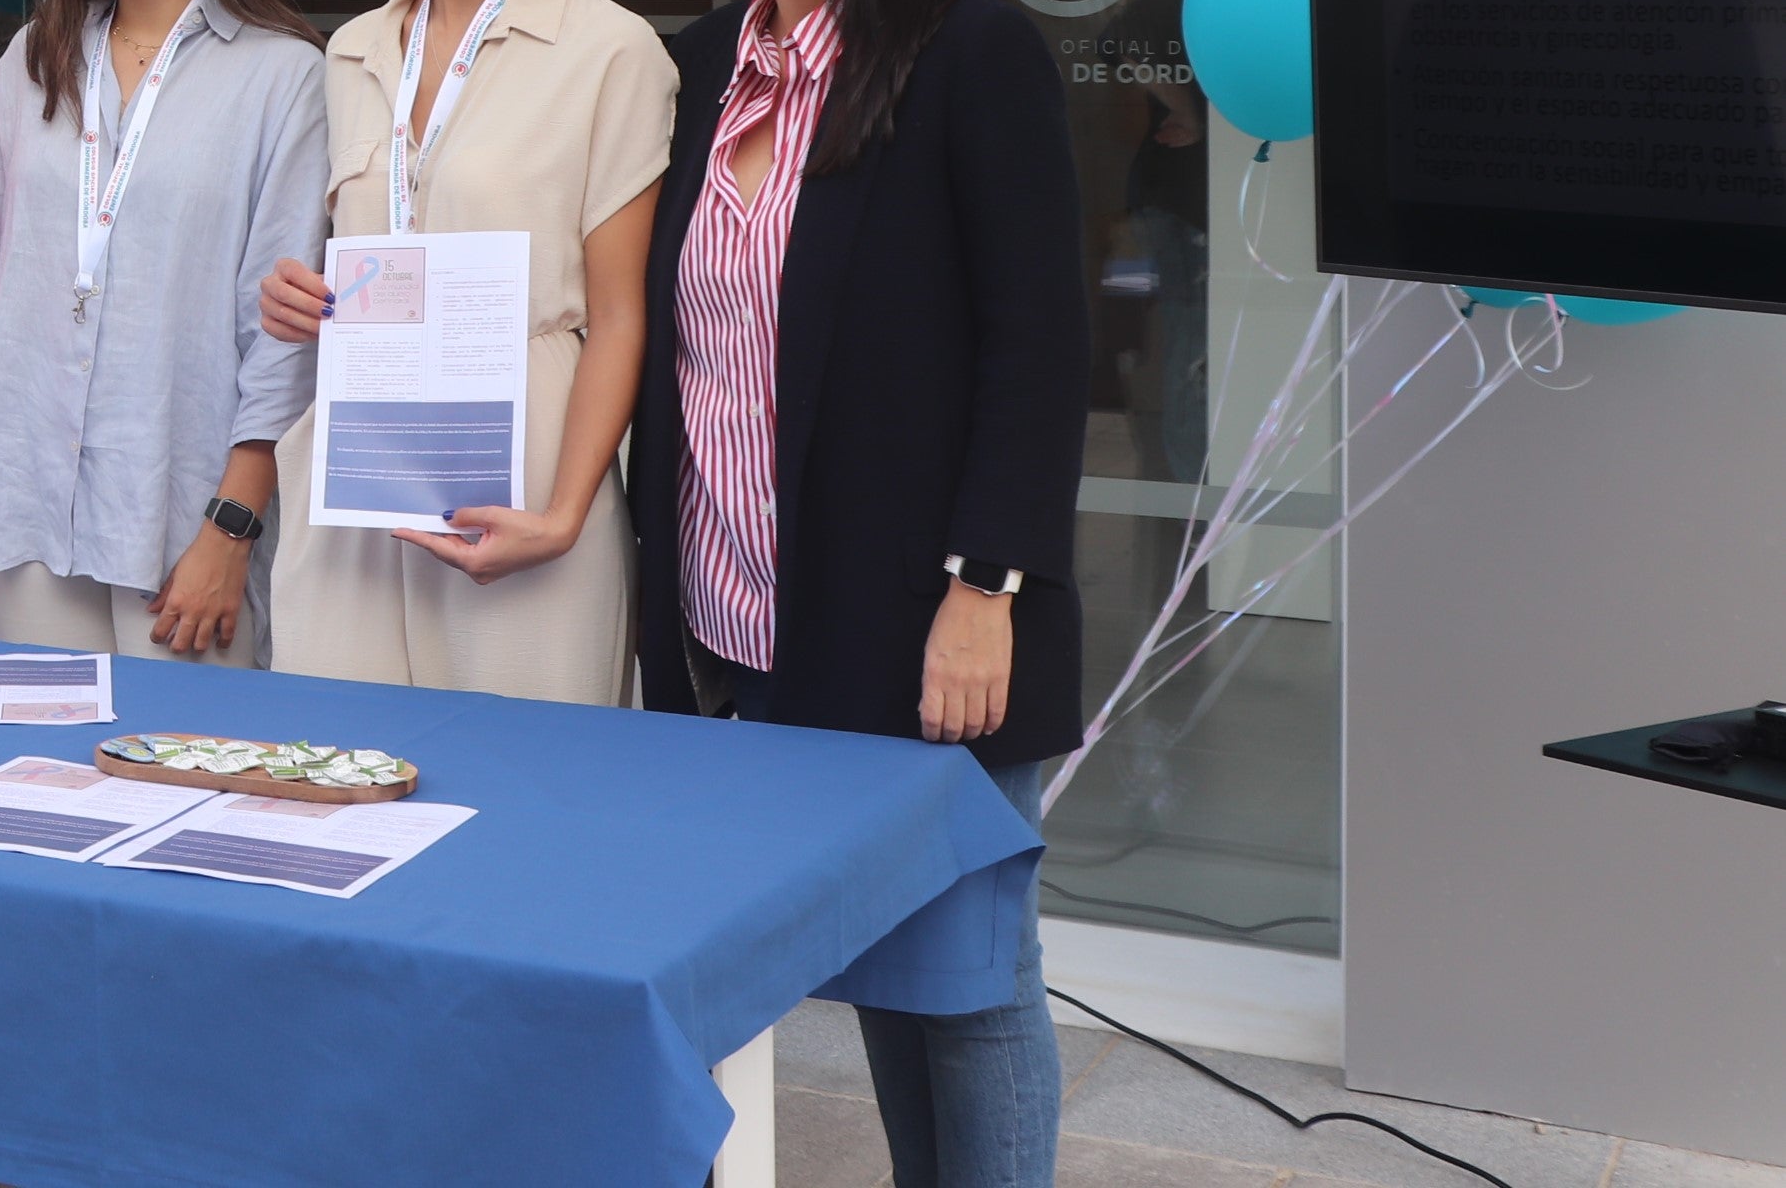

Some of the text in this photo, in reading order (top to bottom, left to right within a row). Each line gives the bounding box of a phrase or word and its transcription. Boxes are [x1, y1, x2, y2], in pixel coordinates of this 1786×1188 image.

[1577, 0, 1606, 23] de
[1061, 40, 1182, 56] OFICIAL D
[1073, 57, 1193, 85] DE CÓRD
[1512, 67, 1605, 90] sanitaria
[1614, 70, 1744, 99] respetuosa
[1537, 95, 1621, 122] espacio
[1628, 97, 1746, 124] adecuado
[1754, 101, 1786, 129] pa
[1580, 135, 1645, 161] social
[1652, 143, 1704, 172] para
[1712, 145, 1759, 170] que
[1528, 158, 1547, 183] la
[1553, 161, 1690, 192] sensibilidad
[1716, 172, 1786, 200] empa
[384, 259, 394, 272] 15
